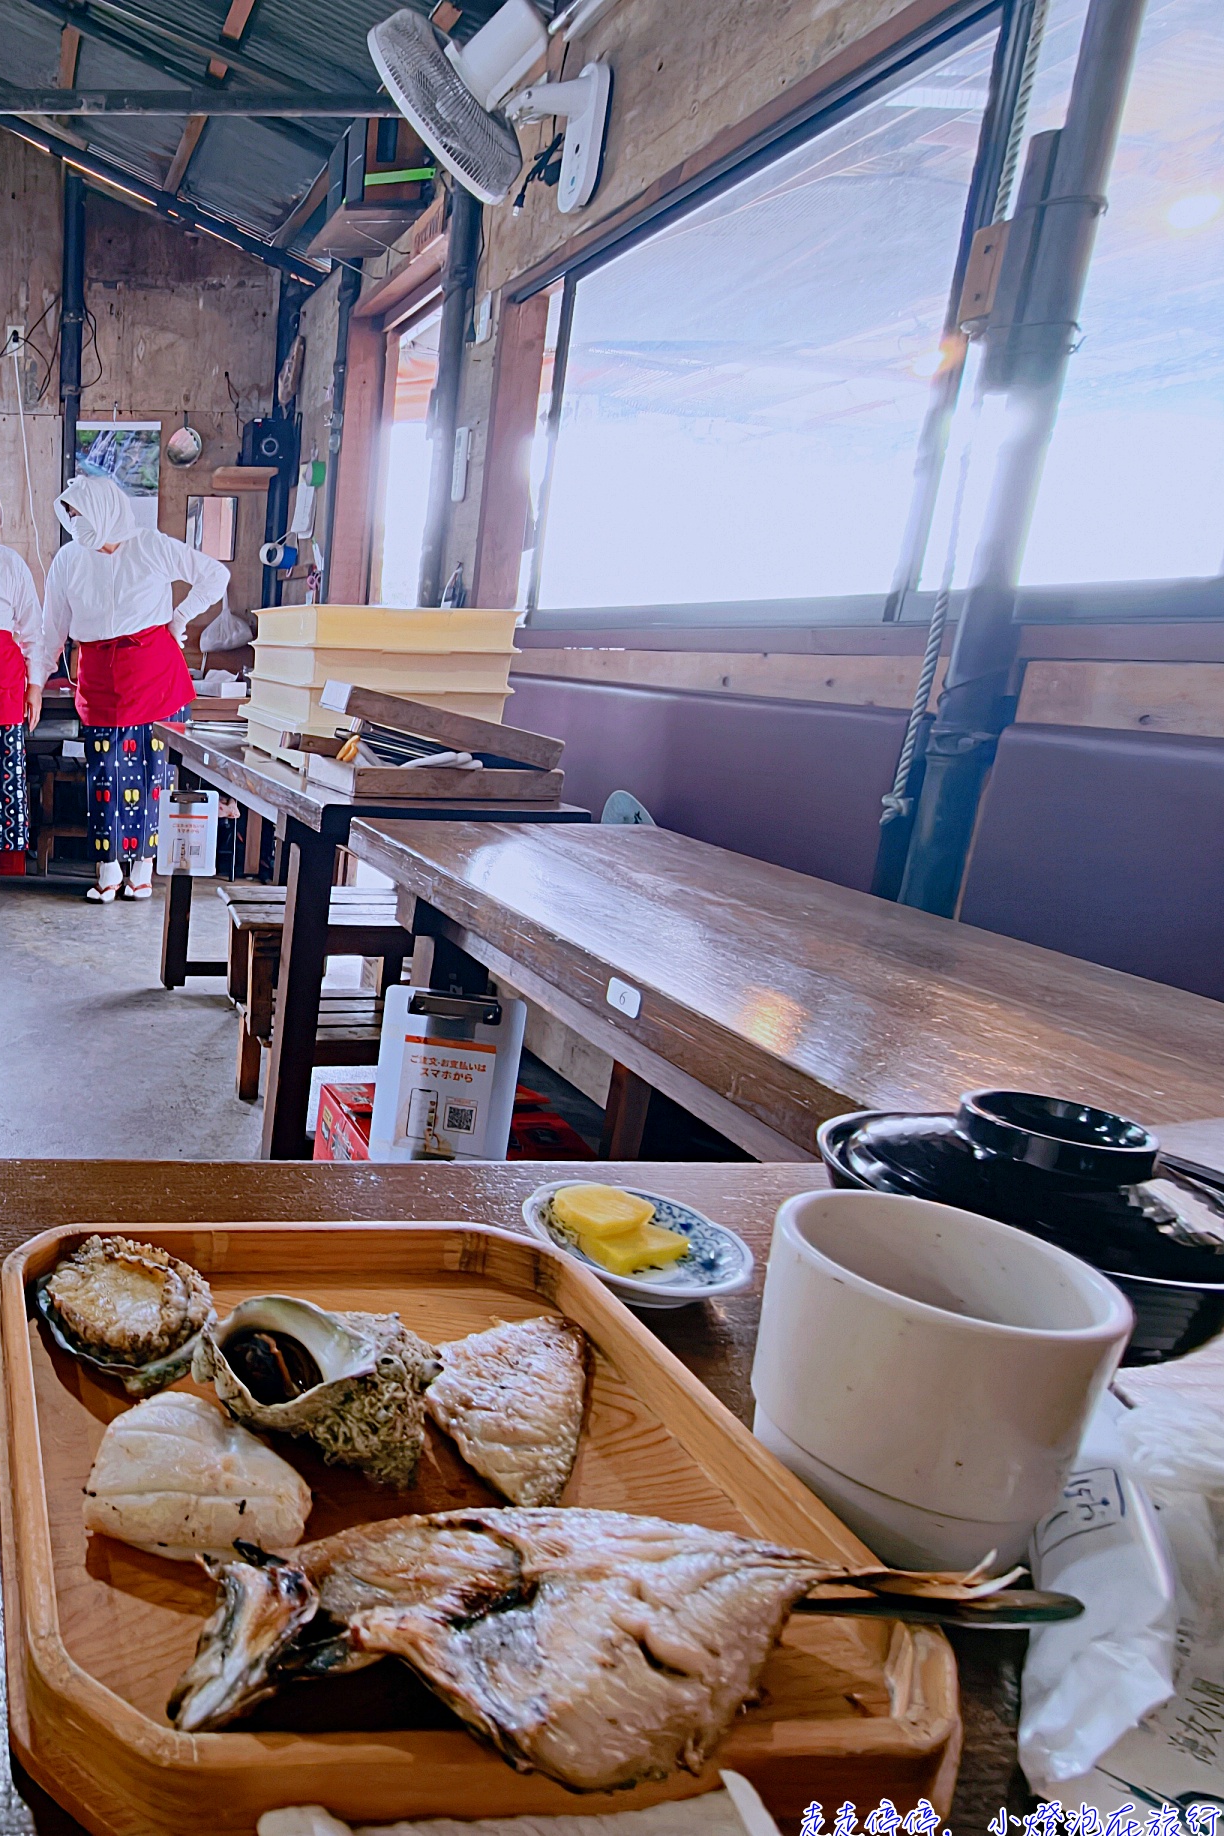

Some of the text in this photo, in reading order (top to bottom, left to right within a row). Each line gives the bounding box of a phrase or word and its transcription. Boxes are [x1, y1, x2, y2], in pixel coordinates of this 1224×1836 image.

[619, 992, 628, 1005] 6
[420, 1067, 474, 1083] スマホから
